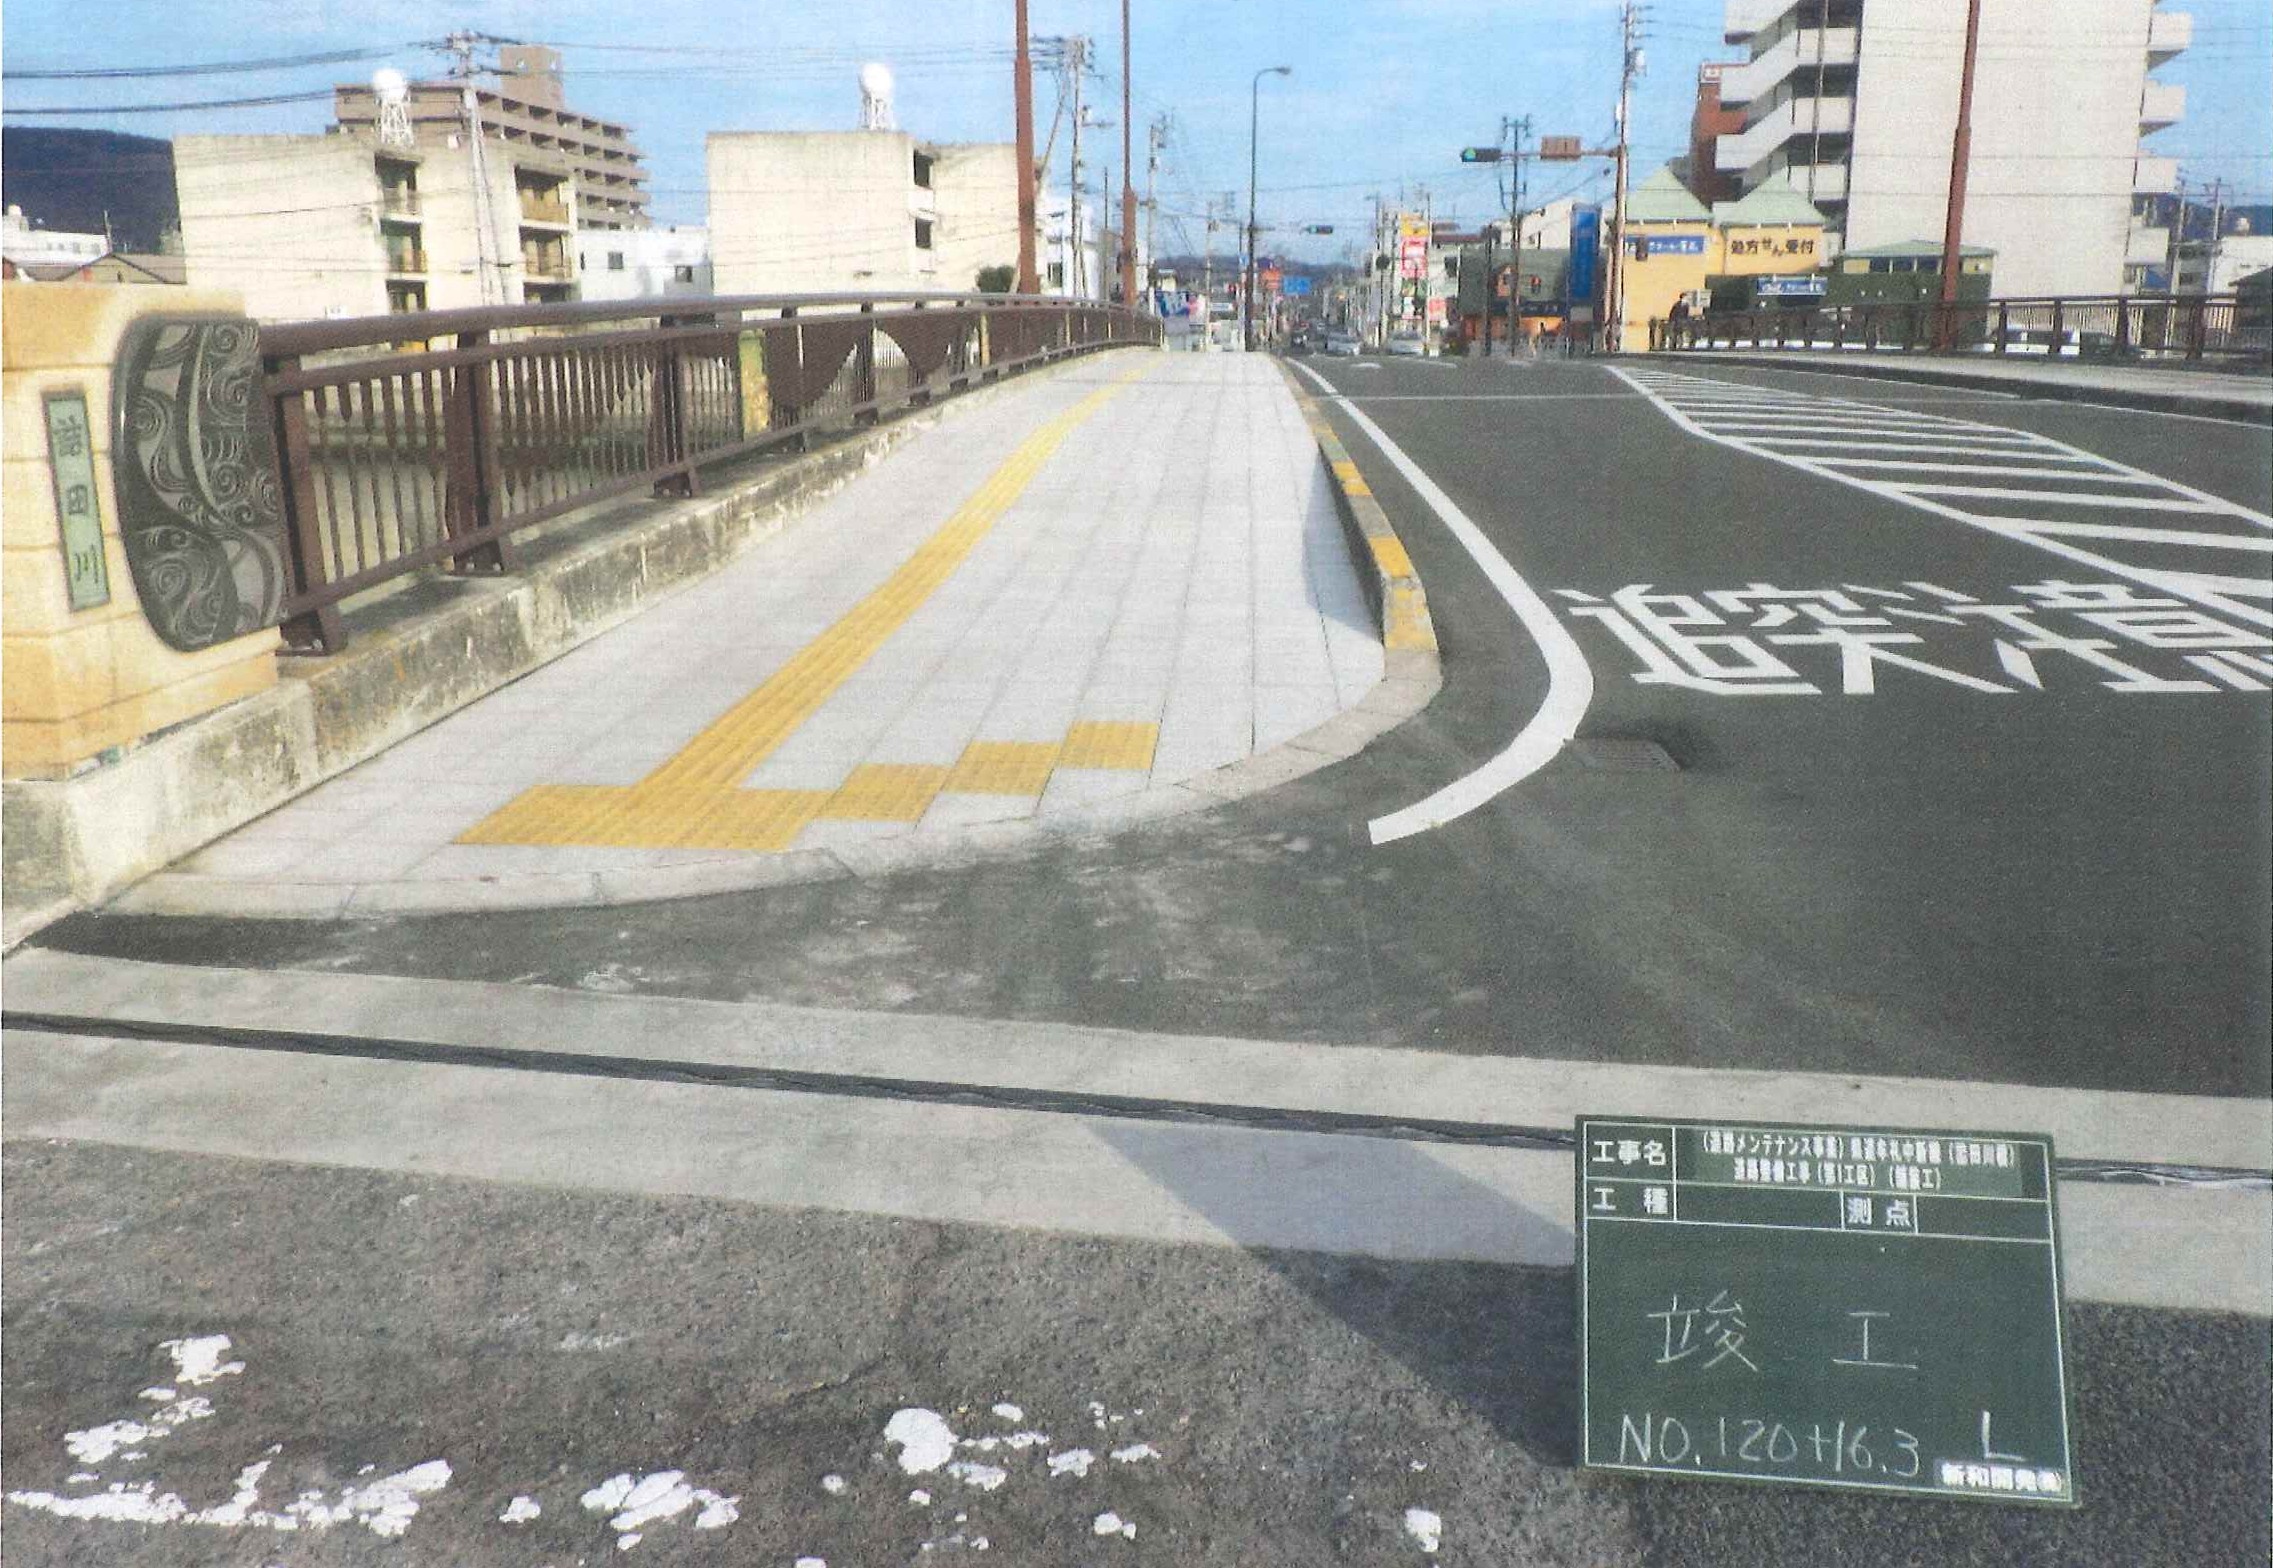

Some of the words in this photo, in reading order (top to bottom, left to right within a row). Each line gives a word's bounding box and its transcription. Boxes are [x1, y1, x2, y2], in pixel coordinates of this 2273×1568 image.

[1730, 236, 1815, 257] 処方せん受付
[1592, 1139, 1667, 1166] 工事名
